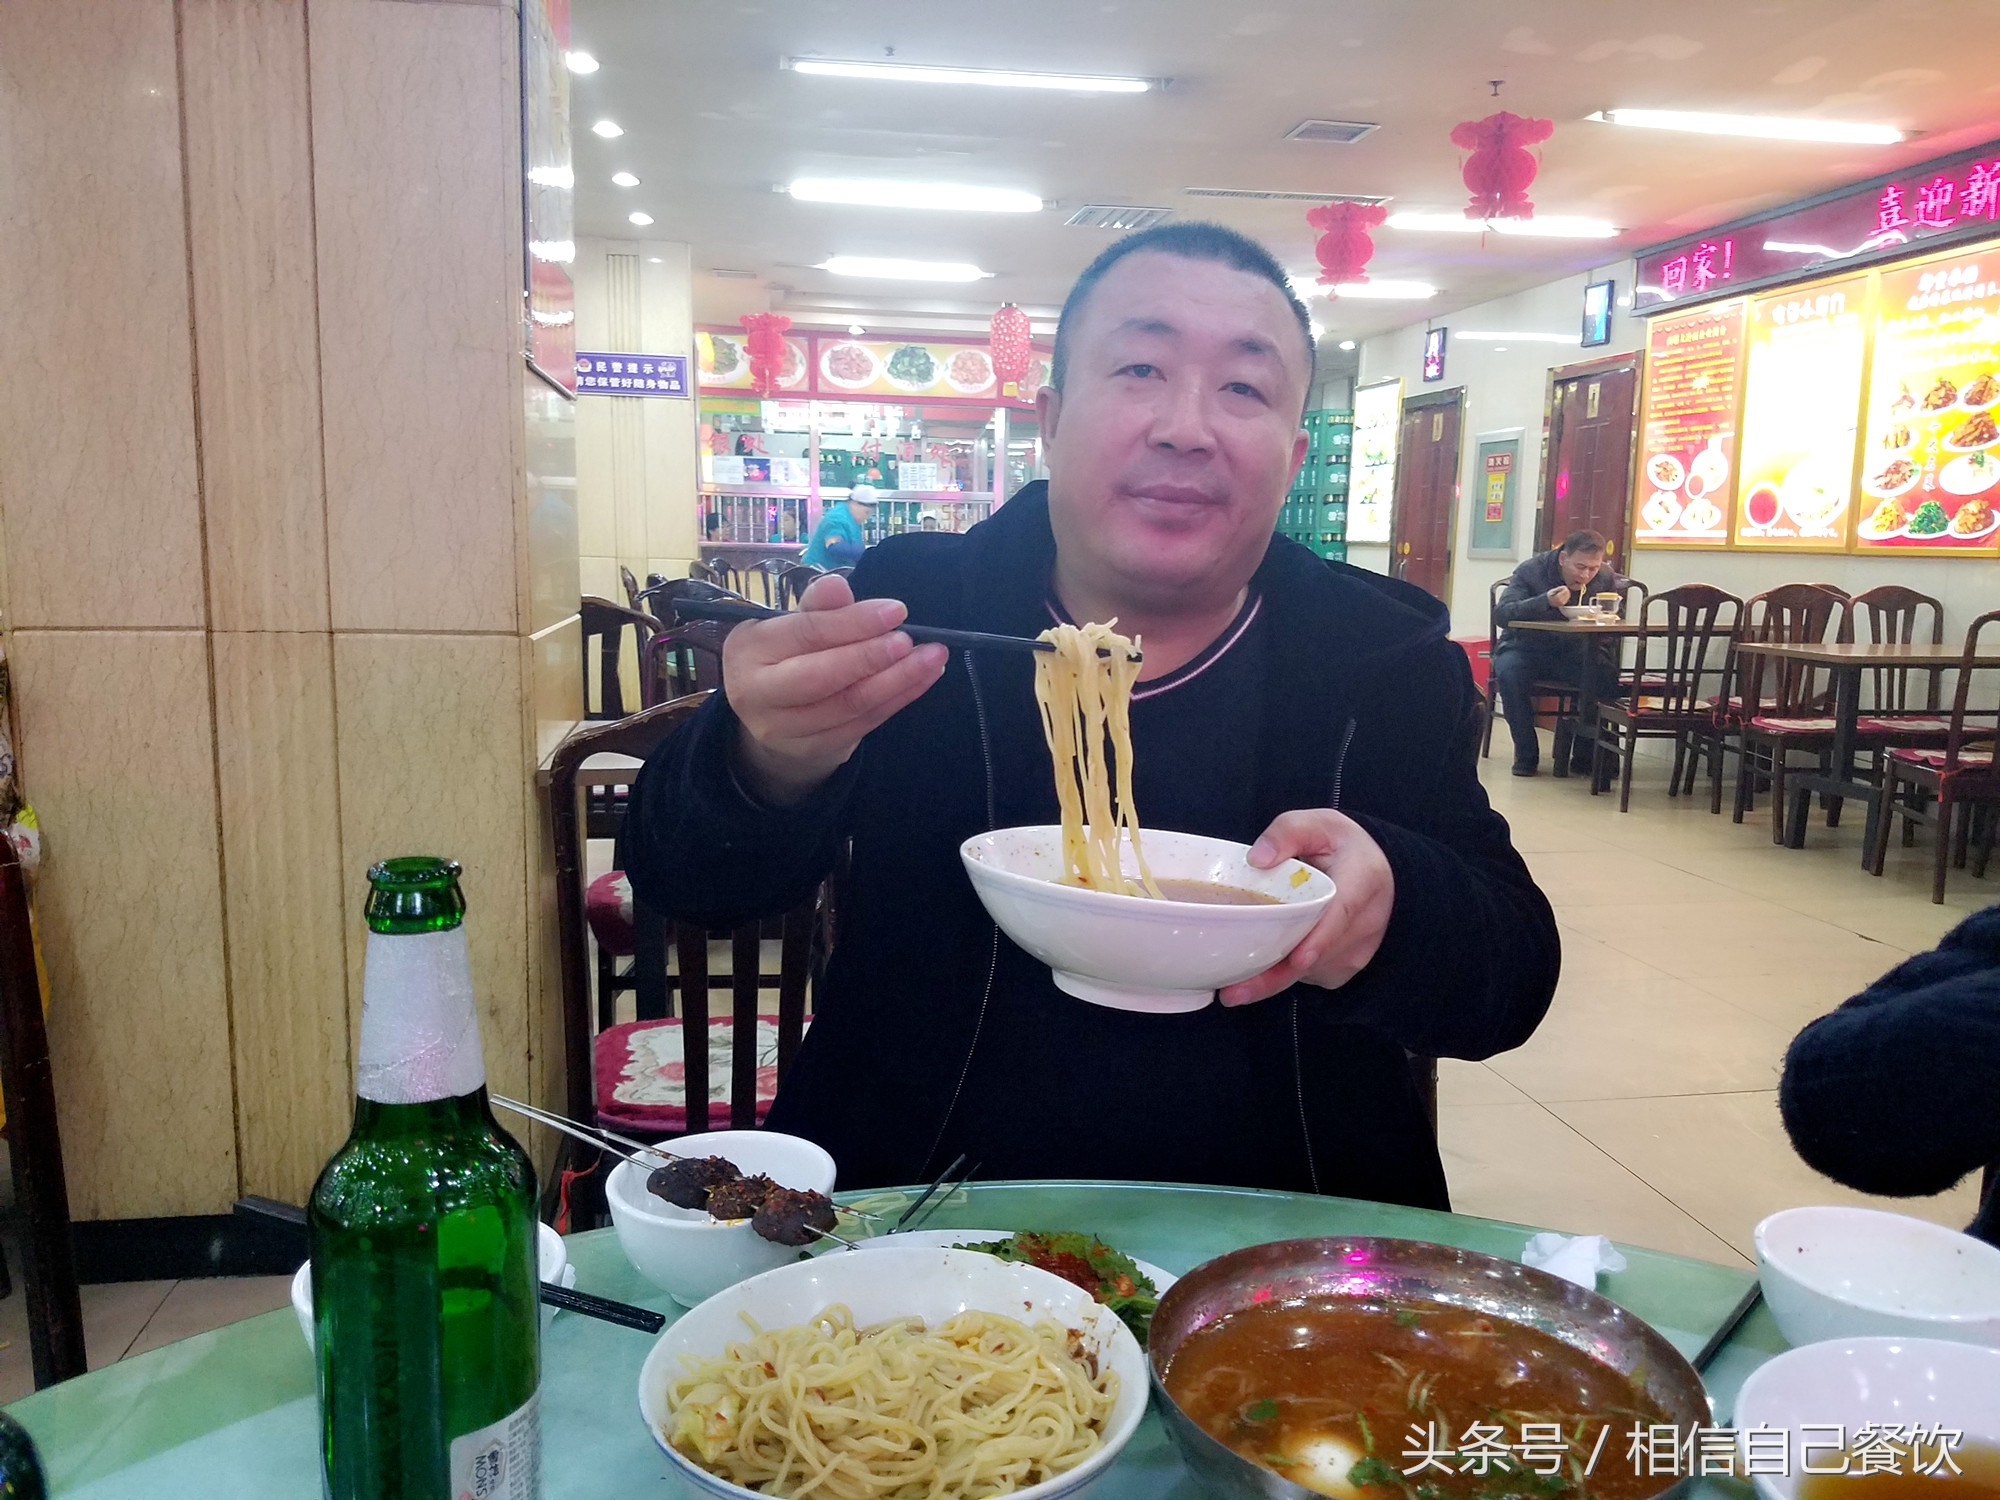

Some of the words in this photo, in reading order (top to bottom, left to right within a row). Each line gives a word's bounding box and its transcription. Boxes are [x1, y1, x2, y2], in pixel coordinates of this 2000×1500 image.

[1869, 161, 2000, 248] 喜迎新
[596, 361, 654, 375] 民警提示
[474, 1455, 488, 1498] SNOW
